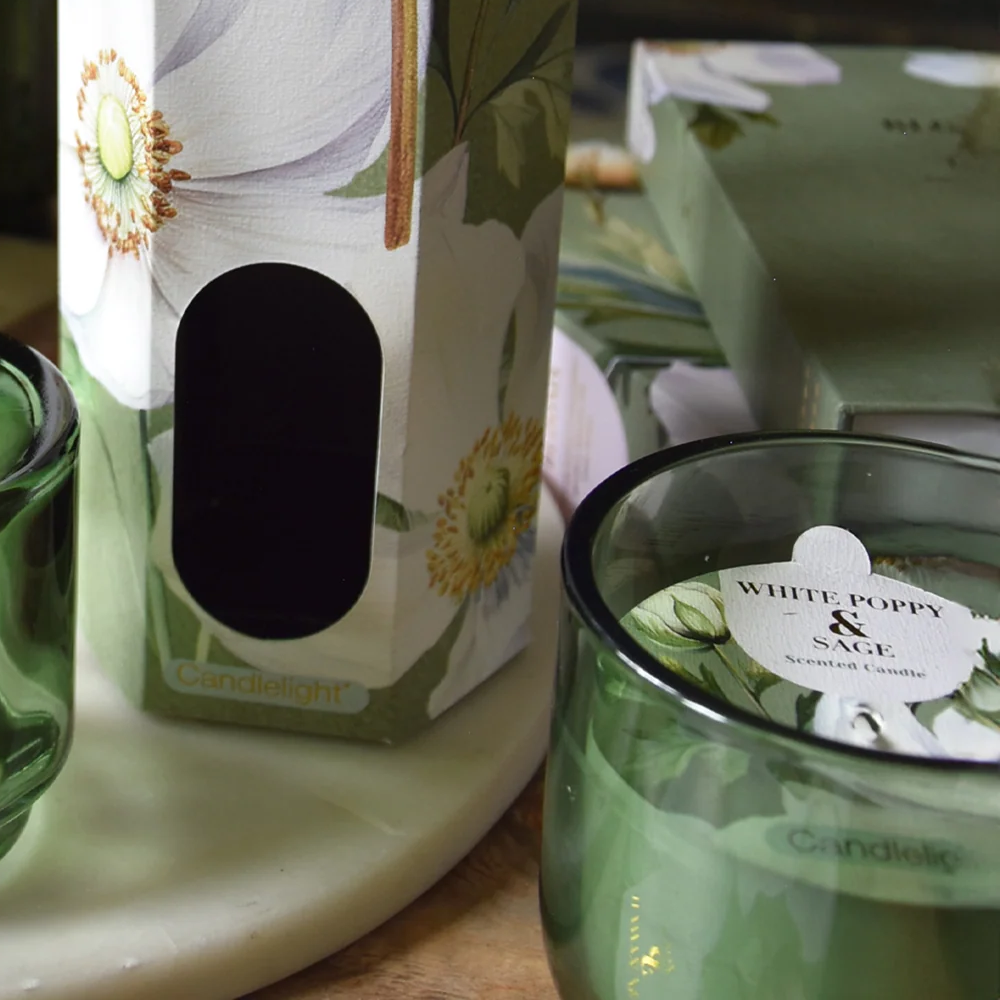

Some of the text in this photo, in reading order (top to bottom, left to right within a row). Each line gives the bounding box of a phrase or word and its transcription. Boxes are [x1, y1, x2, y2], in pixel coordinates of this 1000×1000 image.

[737, 580, 944, 619] WHITE POPPY
[828, 609, 871, 638] &
[812, 635, 896, 659] SAGE
[784, 653, 927, 680] Scented Candle
